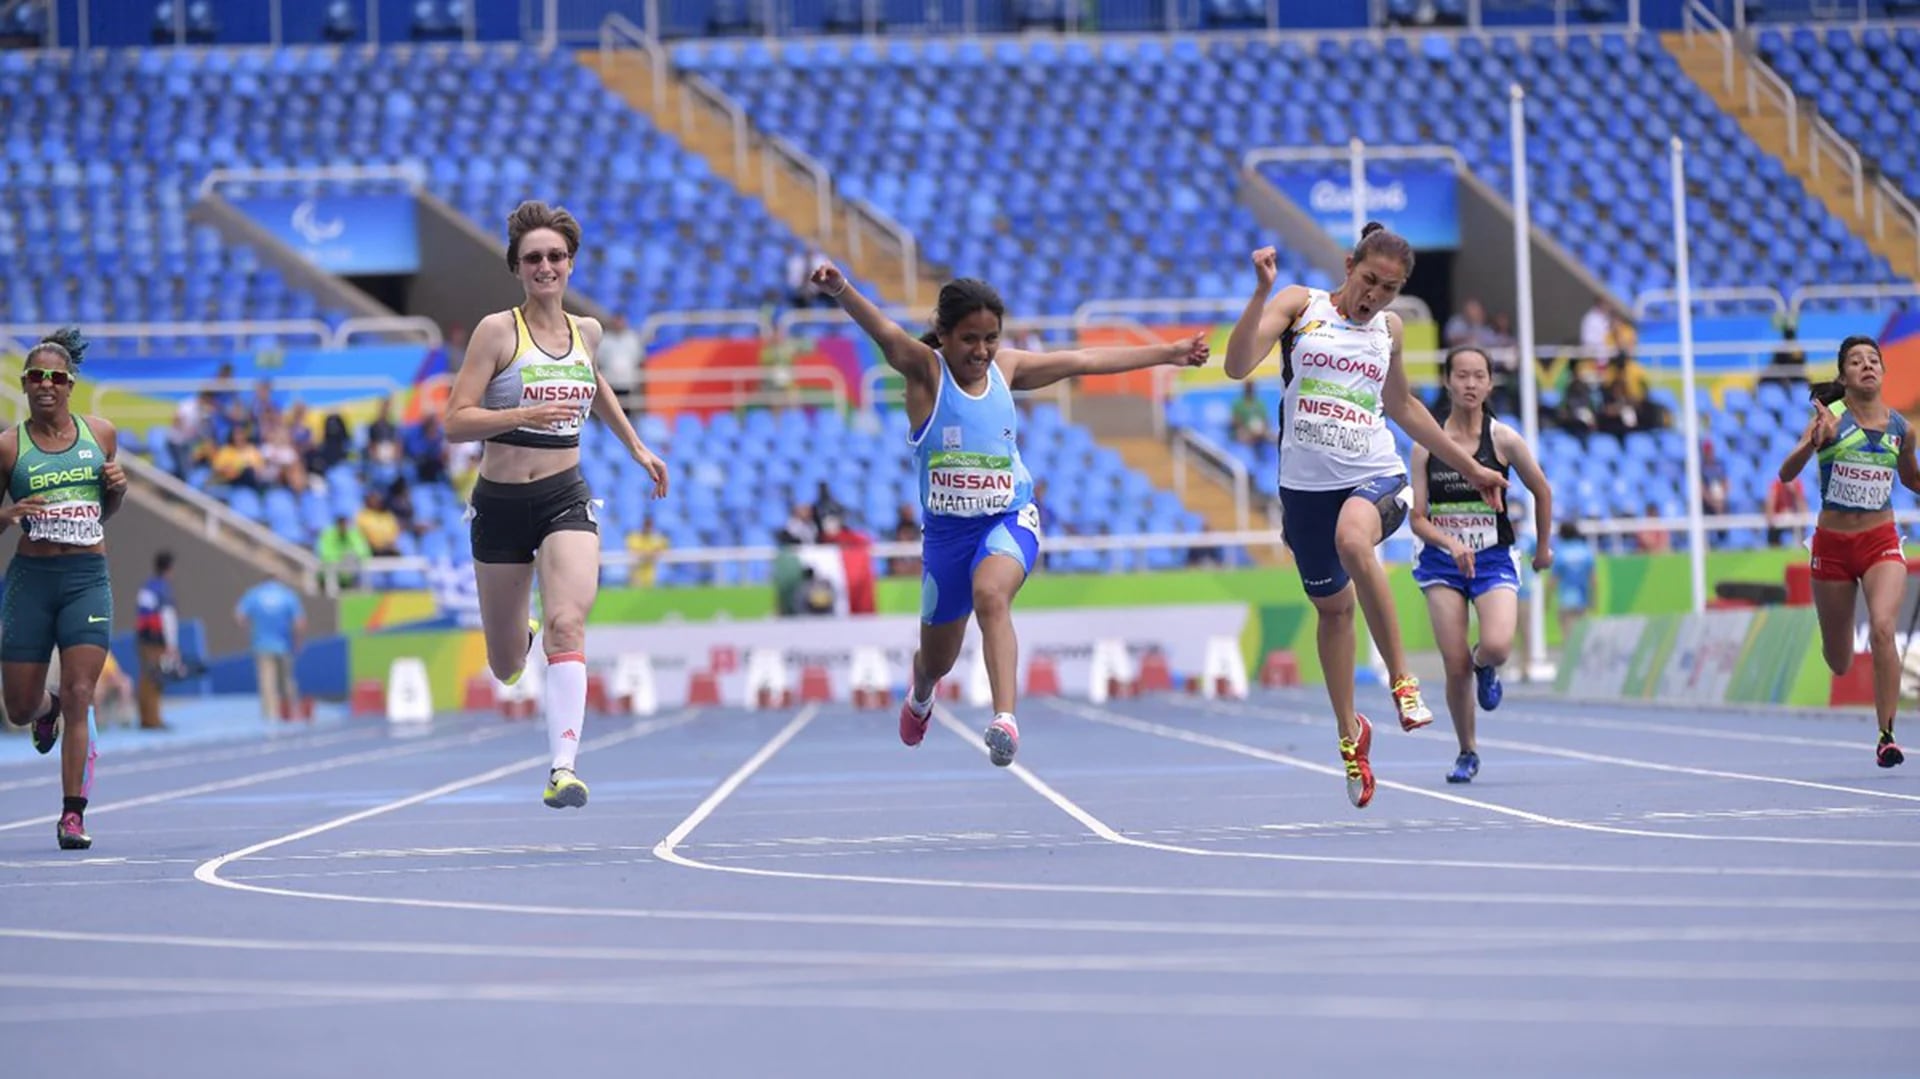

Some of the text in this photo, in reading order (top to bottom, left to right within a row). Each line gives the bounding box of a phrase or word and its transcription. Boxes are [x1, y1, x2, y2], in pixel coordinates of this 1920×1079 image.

[523, 386, 595, 401] NISSAN
[1298, 398, 1372, 426] NISSAN
[30, 466, 98, 490] BRASIL
[931, 471, 1012, 489] NISSAN
[1833, 463, 1893, 481] NISSAN
[930, 492, 1009, 512] MARTINEZ
[1433, 516, 1494, 529] NISSAN
